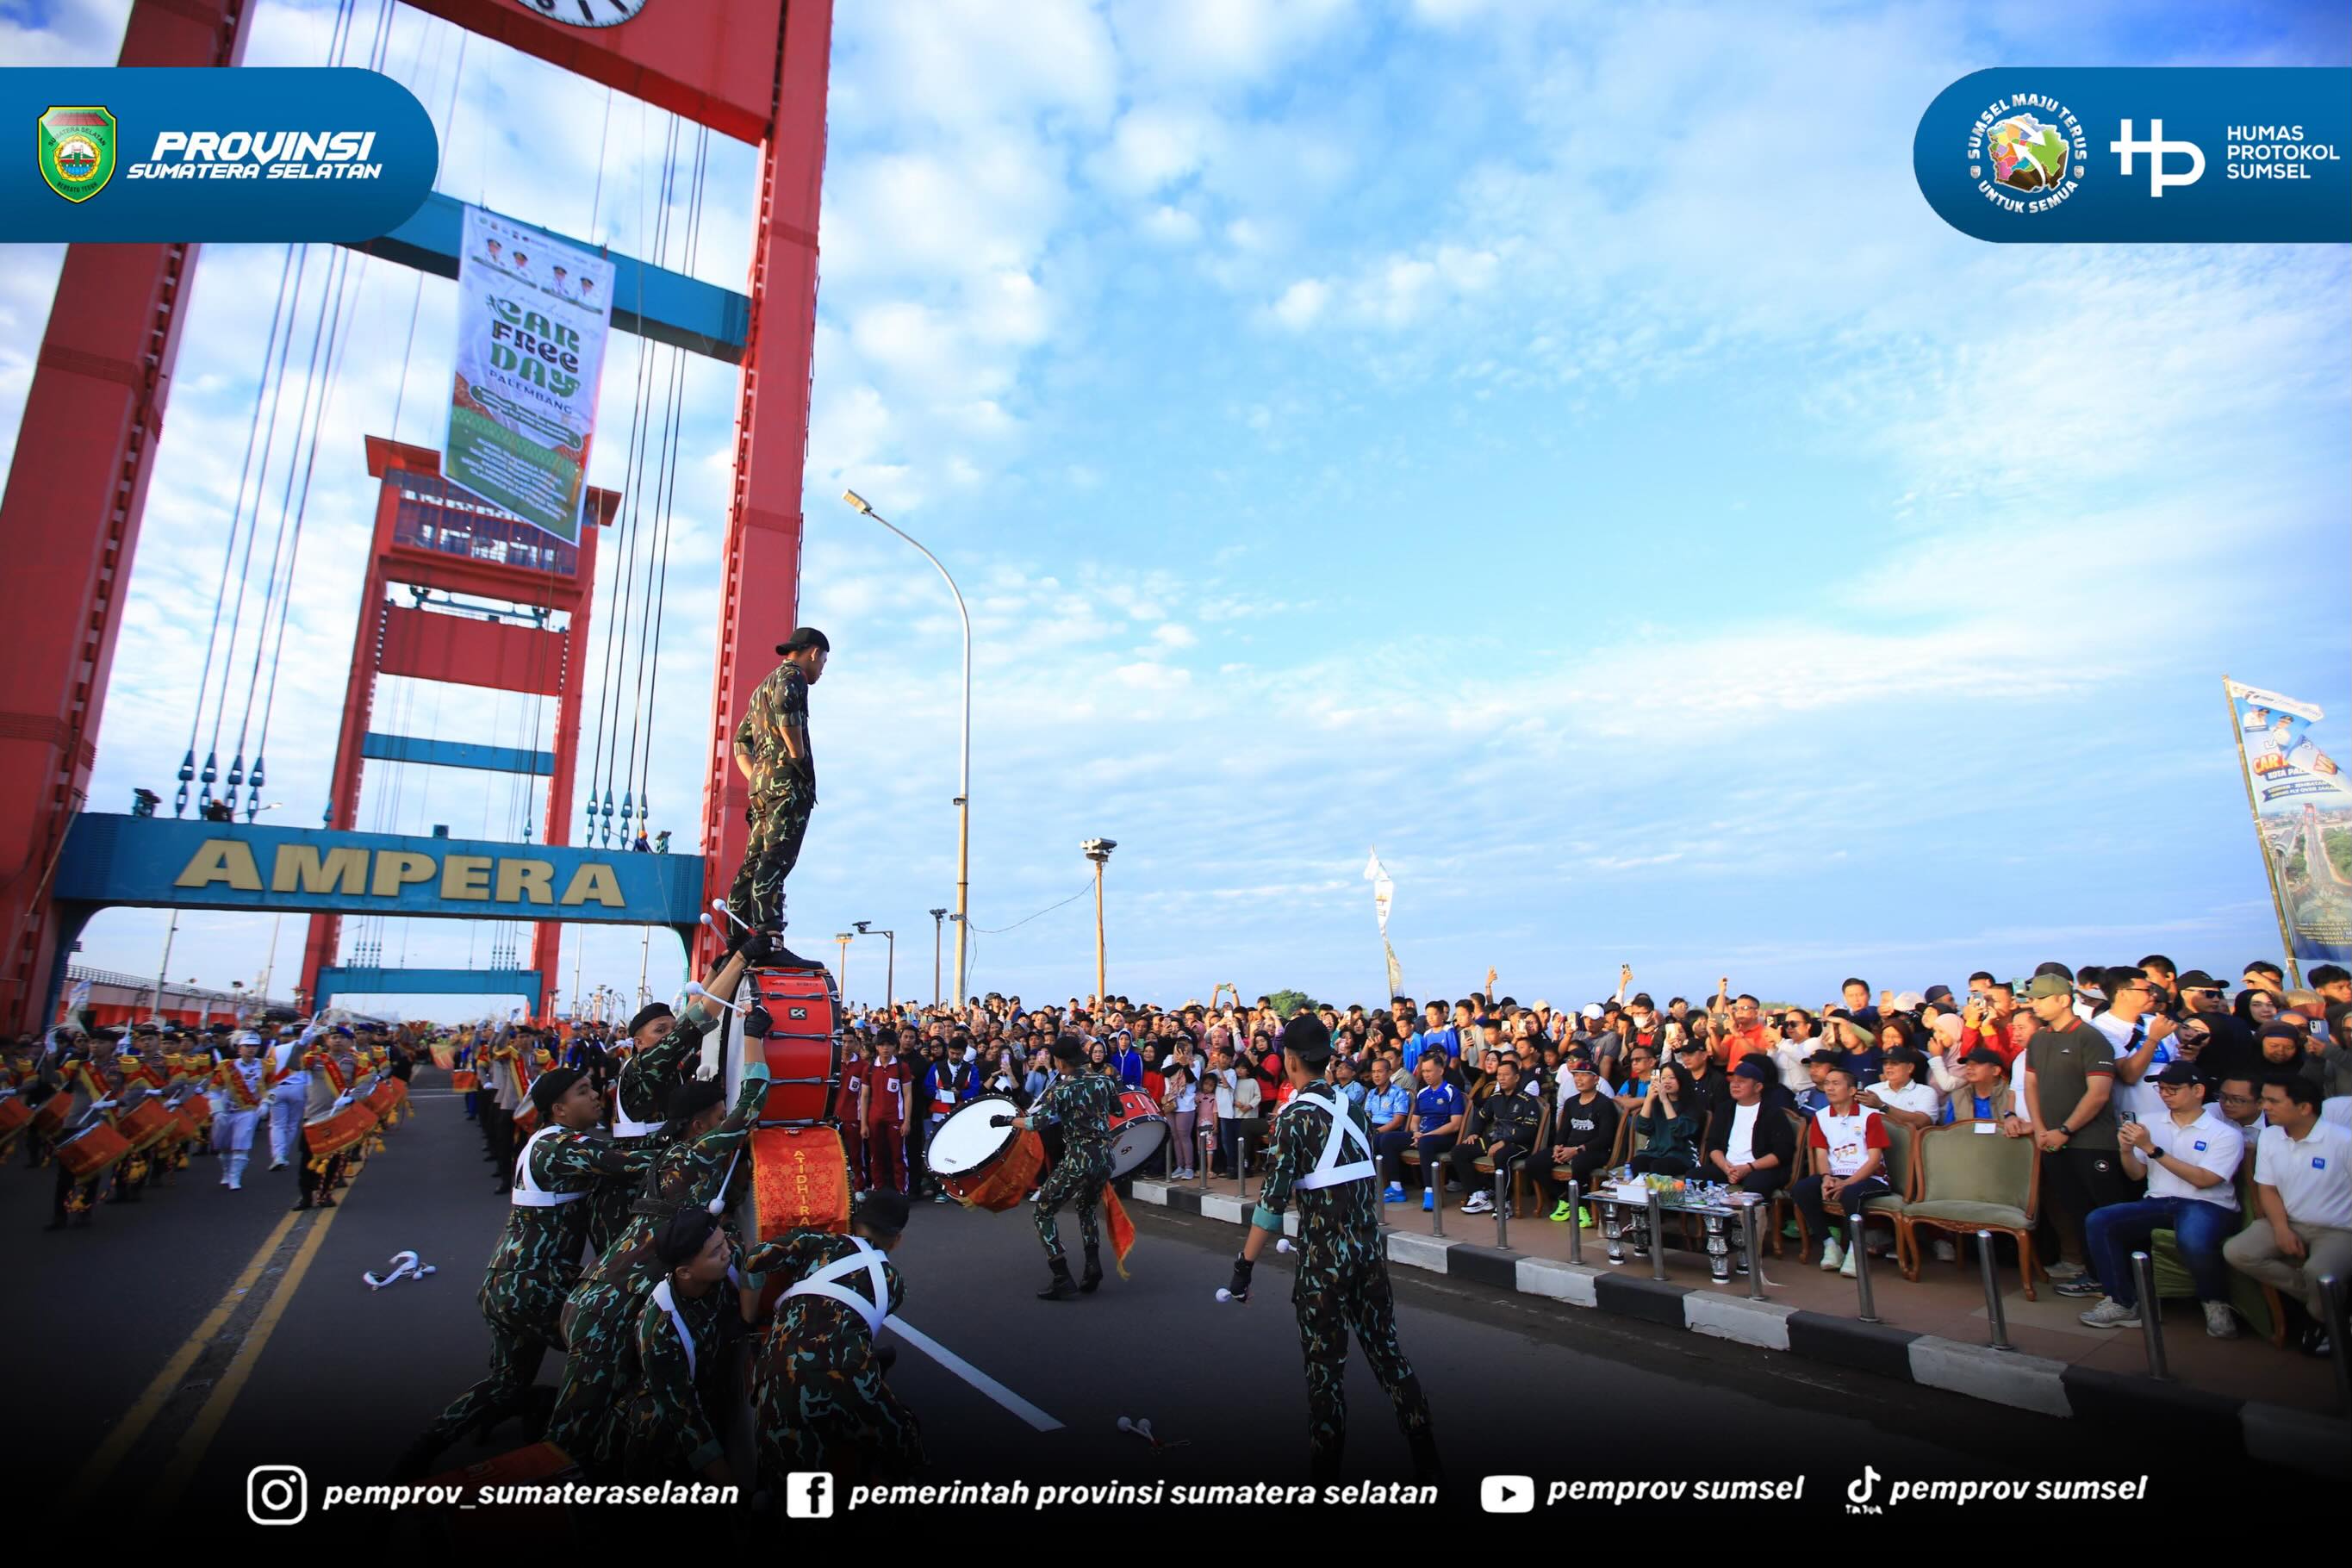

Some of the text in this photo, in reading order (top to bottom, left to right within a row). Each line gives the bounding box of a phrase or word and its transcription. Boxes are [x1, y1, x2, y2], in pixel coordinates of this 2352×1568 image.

[495, 298, 580, 354] CAR
[489, 370, 572, 414] PALEMBANG
[174, 838, 626, 907] AMPERA
[793, 1150, 810, 1227] ATIDHIRA
